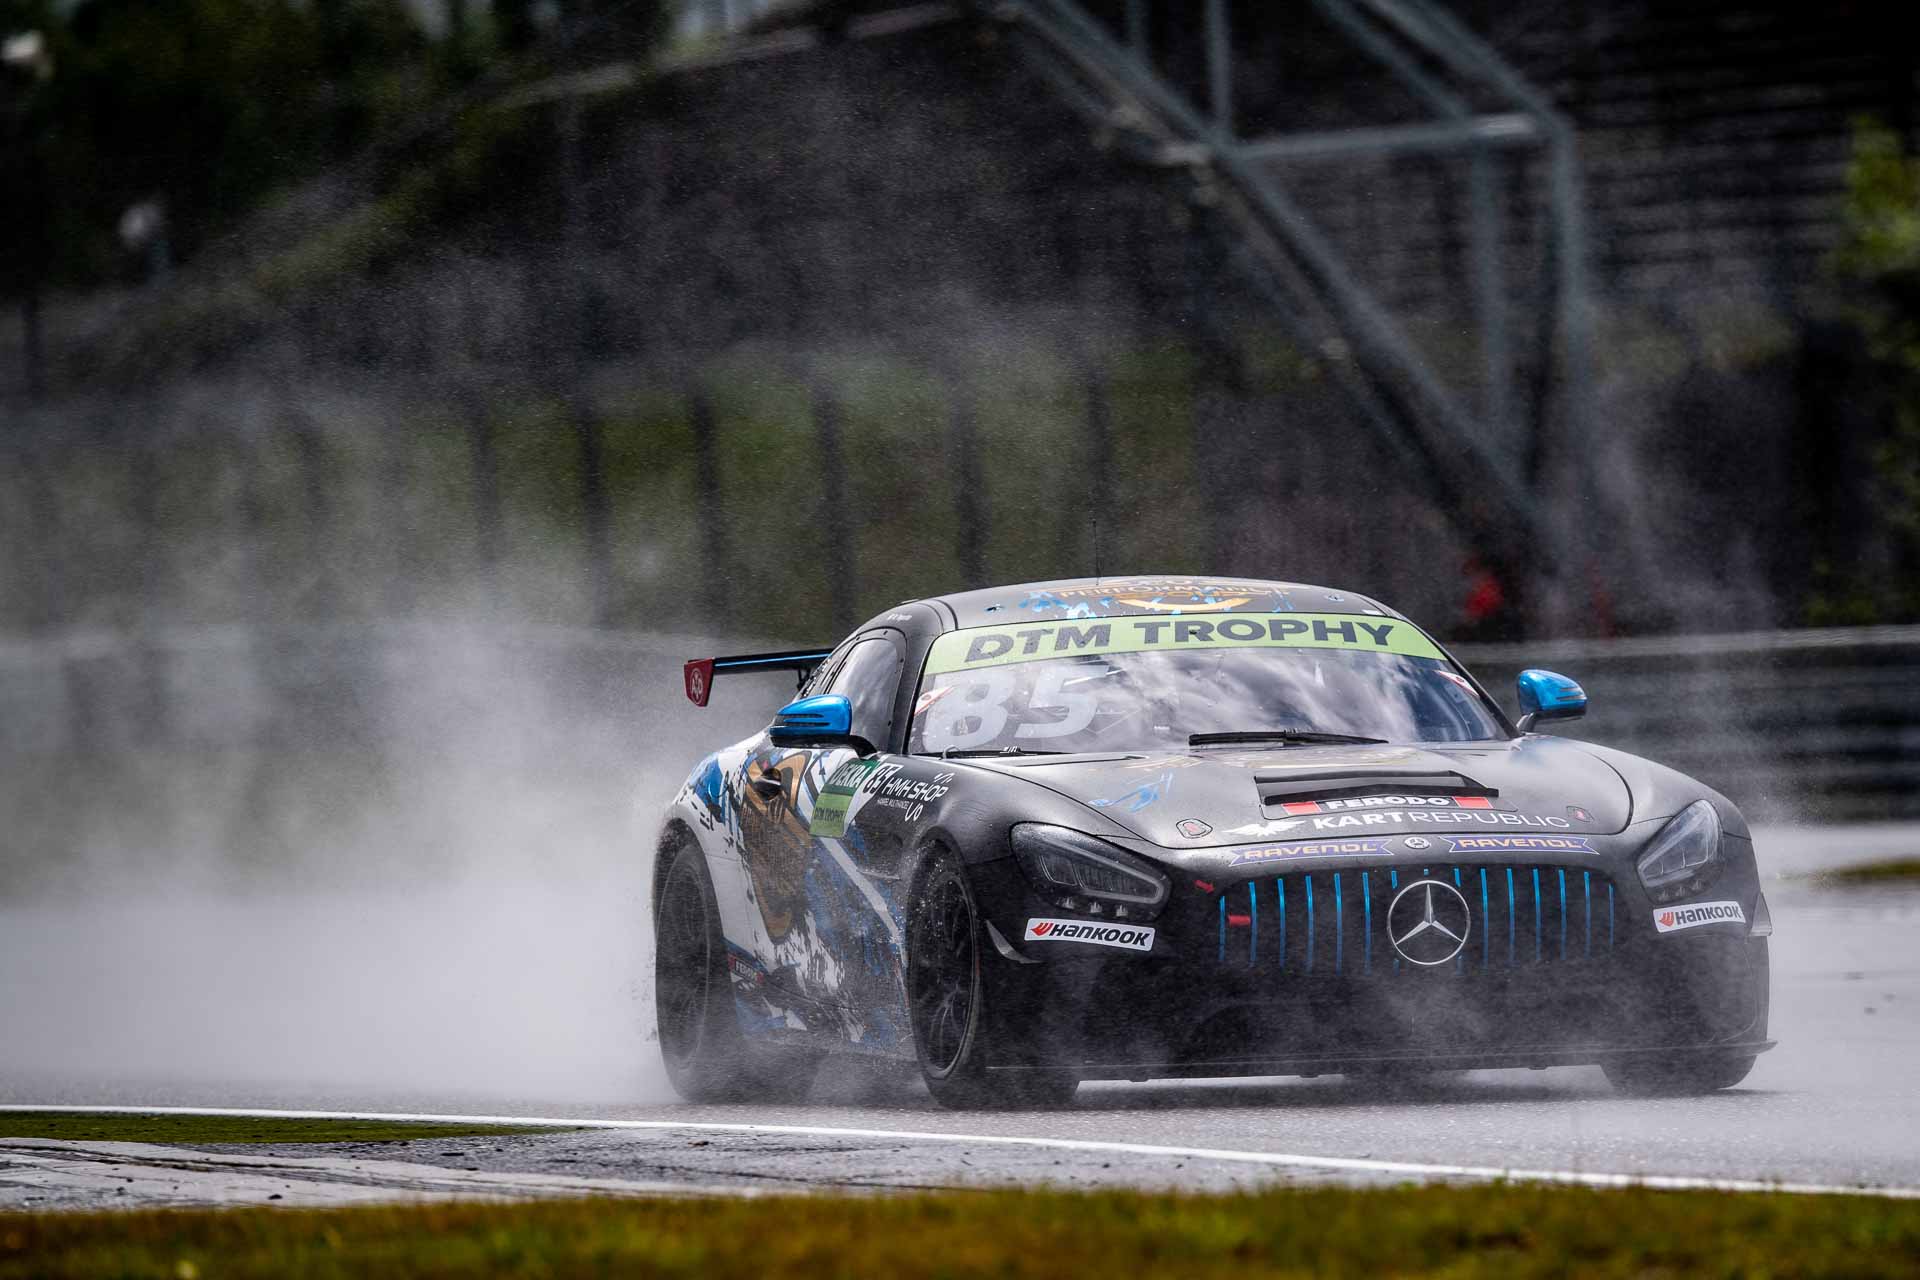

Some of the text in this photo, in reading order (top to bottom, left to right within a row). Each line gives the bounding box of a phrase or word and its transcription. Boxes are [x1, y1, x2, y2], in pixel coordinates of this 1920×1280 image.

[964, 618, 1396, 663] DTM TROPHY
[922, 665, 1111, 750] 85
[829, 762, 872, 788] DEKRA
[881, 777, 949, 802] HMH SHOP
[1325, 796, 1450, 810] FERODO
[1244, 843, 1378, 860] RAVENOL
[1457, 838, 1583, 849] RAVENOL
